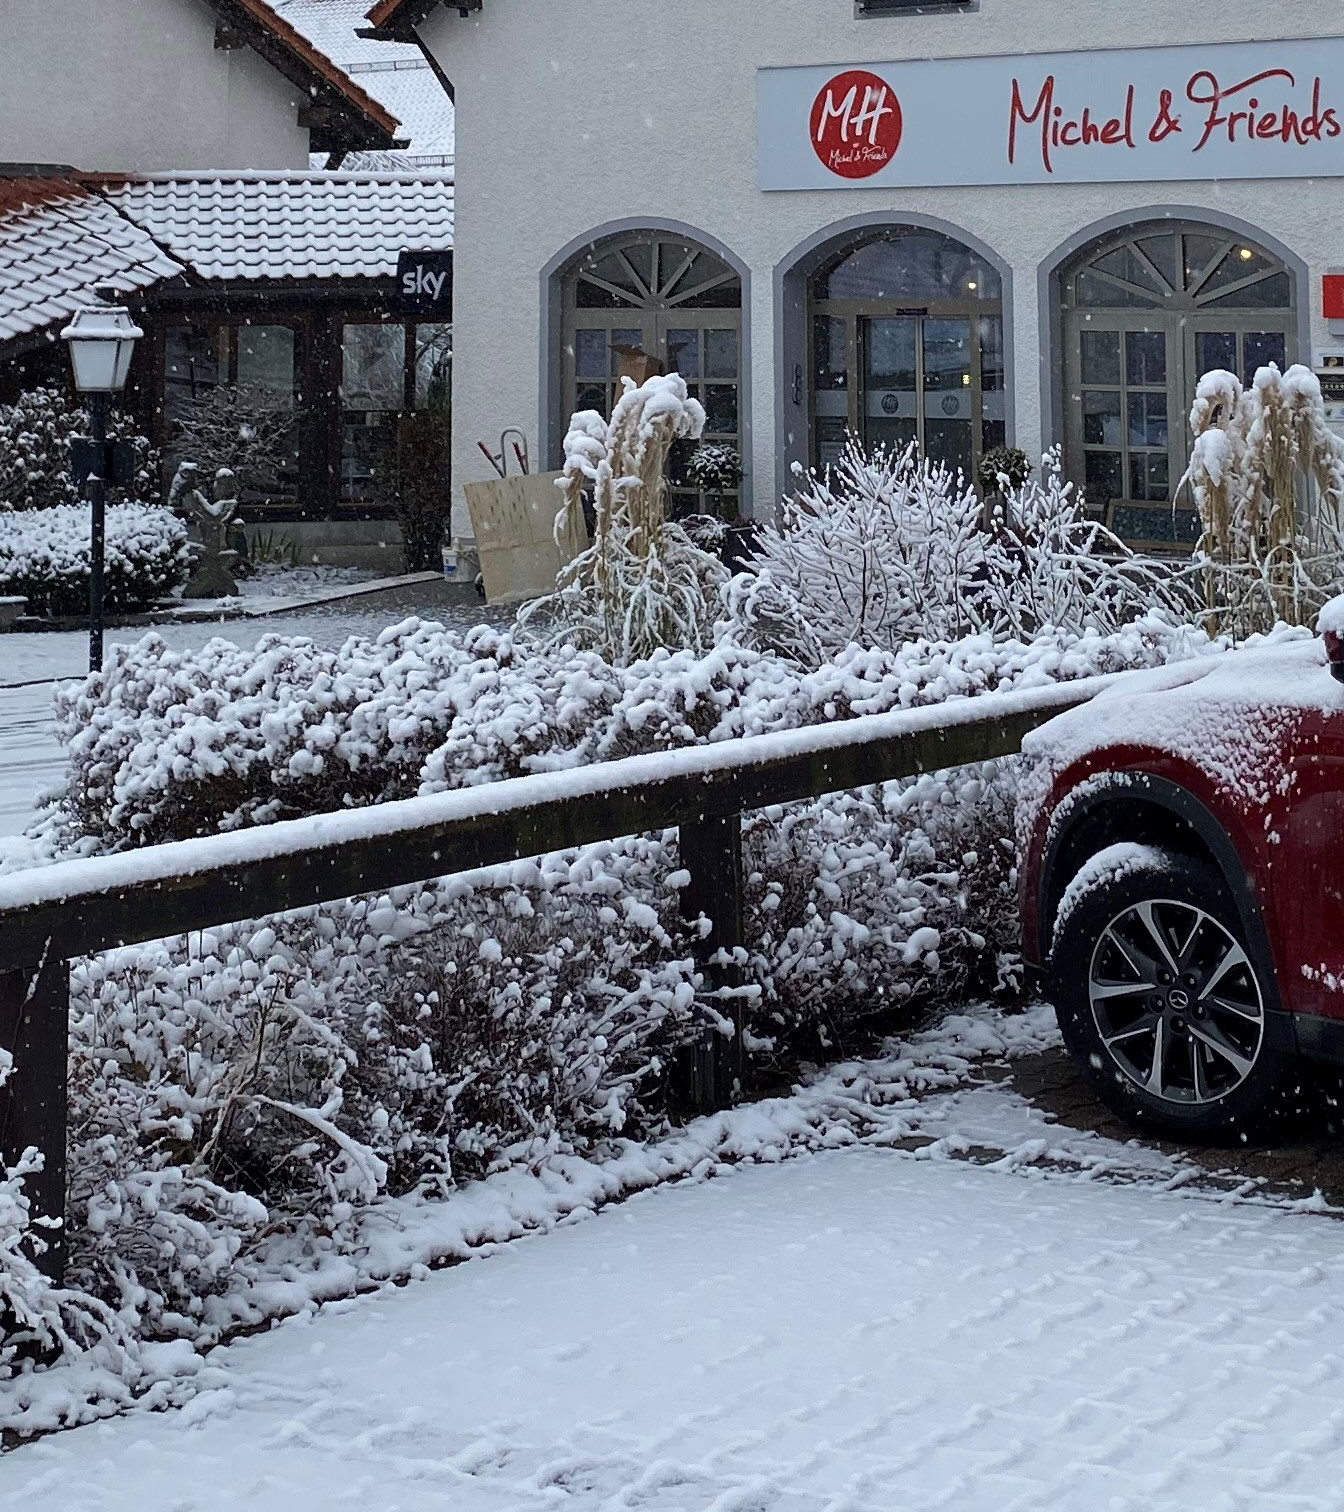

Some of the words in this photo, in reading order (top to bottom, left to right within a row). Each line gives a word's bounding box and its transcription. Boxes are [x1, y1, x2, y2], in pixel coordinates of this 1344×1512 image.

[817, 84, 893, 146] MH
[1006, 74, 1137, 174] Michel
[1147, 88, 1182, 144] &
[1186, 68, 1342, 153] Friends
[402, 264, 447, 301] sky
